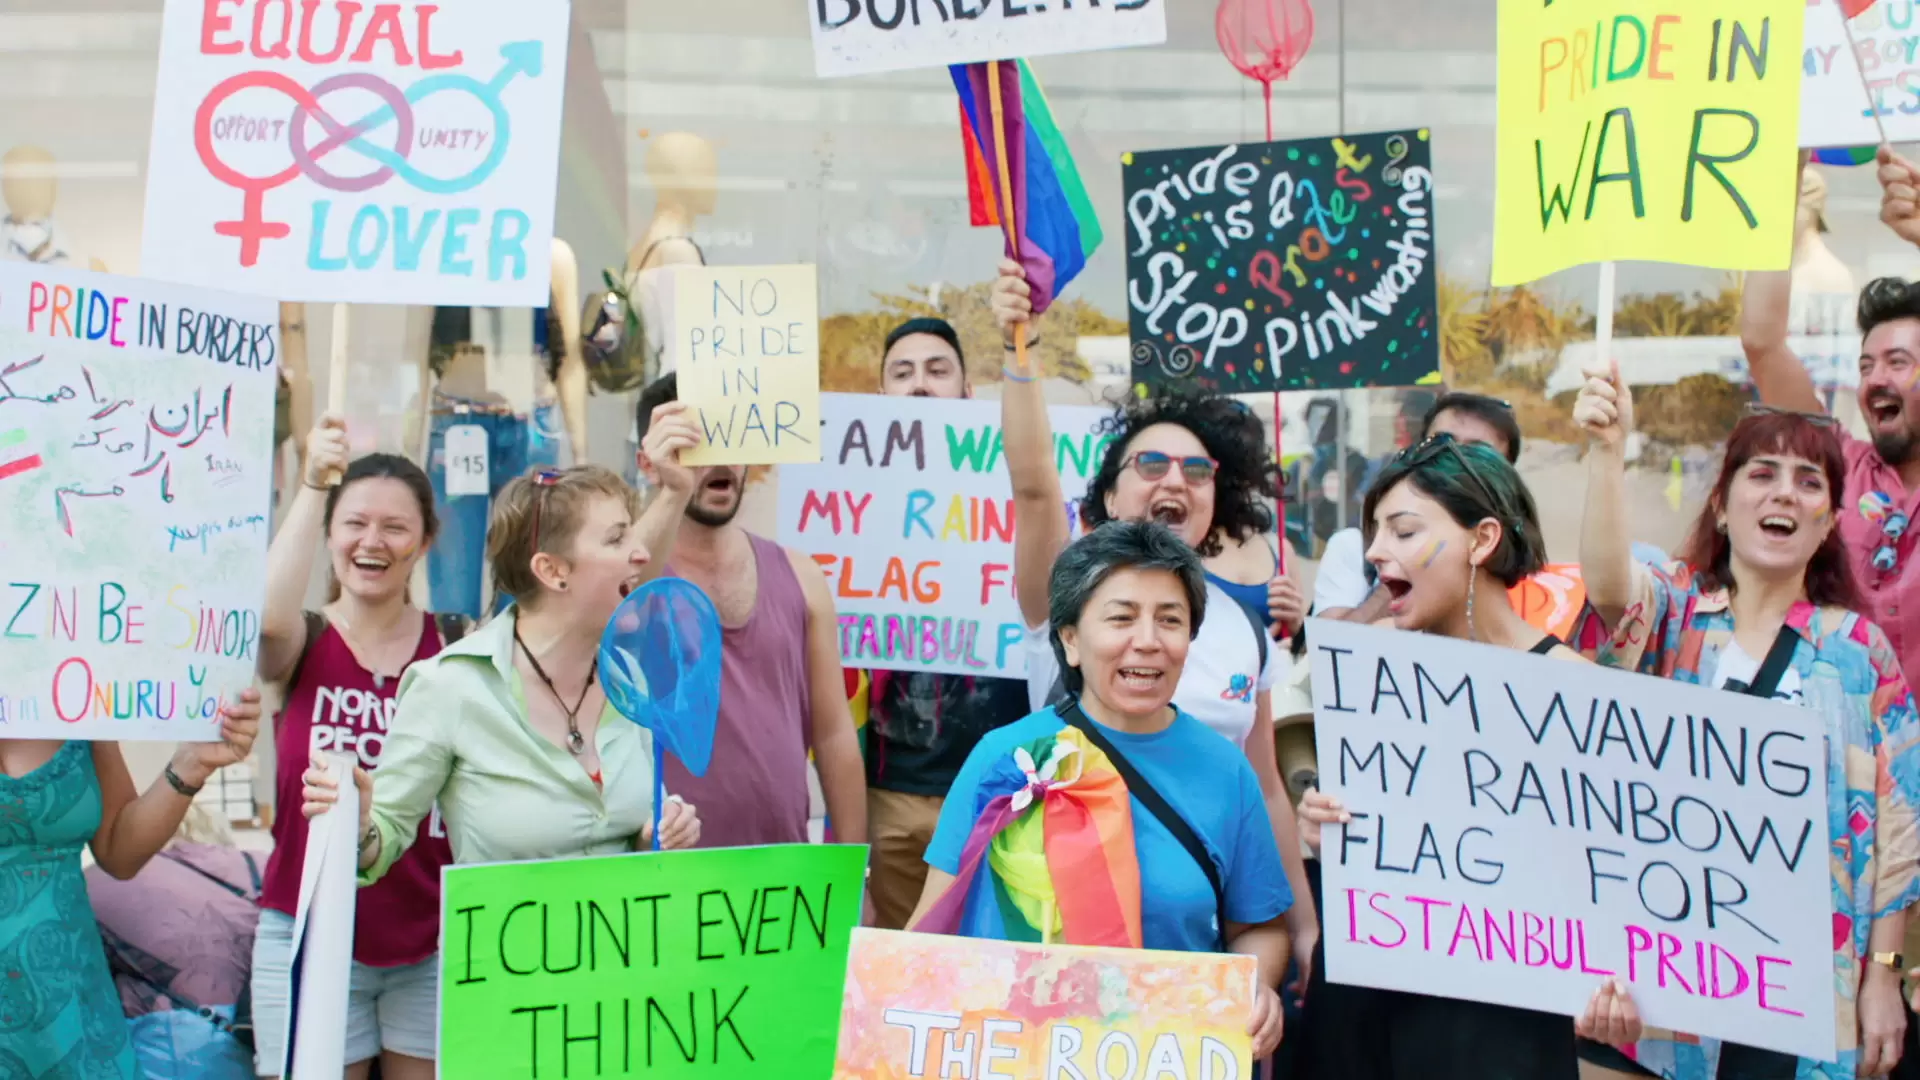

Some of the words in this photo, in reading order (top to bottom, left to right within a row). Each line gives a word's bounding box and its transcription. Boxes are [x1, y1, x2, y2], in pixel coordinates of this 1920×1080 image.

[200, 0, 464, 69] EQUAL
[1539, 14, 1681, 113] PRIDE
[1708, 17, 1770, 82] IN
[418, 127, 489, 150] UNITY
[1535, 107, 1759, 233] WAR
[306, 201, 531, 281] LOVER
[1203, 199, 1255, 249] is
[27, 281, 129, 348] PRIDE
[138, 302, 168, 349] IN
[176, 307, 275, 372] BORDERS
[712, 277, 778, 319] NO
[1129, 251, 1248, 368] Stop
[690, 321, 804, 363] PRIDE
[722, 366, 759, 396] IN
[699, 400, 812, 448] WAR
[839, 419, 926, 471] AM
[797, 489, 873, 536] MY
[1318, 645, 1357, 712] I
[1370, 656, 1481, 734] AM
[1503, 682, 1810, 797] WAVING
[1339, 737, 1427, 797] MY
[1463, 749, 1812, 873] RAINBOW
[1340, 812, 1504, 885] FLAG
[1586, 846, 1780, 945] FOR
[456, 904, 487, 986] I
[500, 893, 671, 976] CUNT
[697, 883, 832, 961] EVEN
[1341, 888, 1616, 976] ISTANBUL
[1624, 924, 1805, 1018] PRIDE
[511, 985, 755, 1079] THINK
[883, 1007, 1023, 1080] THE
[1047, 1024, 1238, 1080] ROAD
